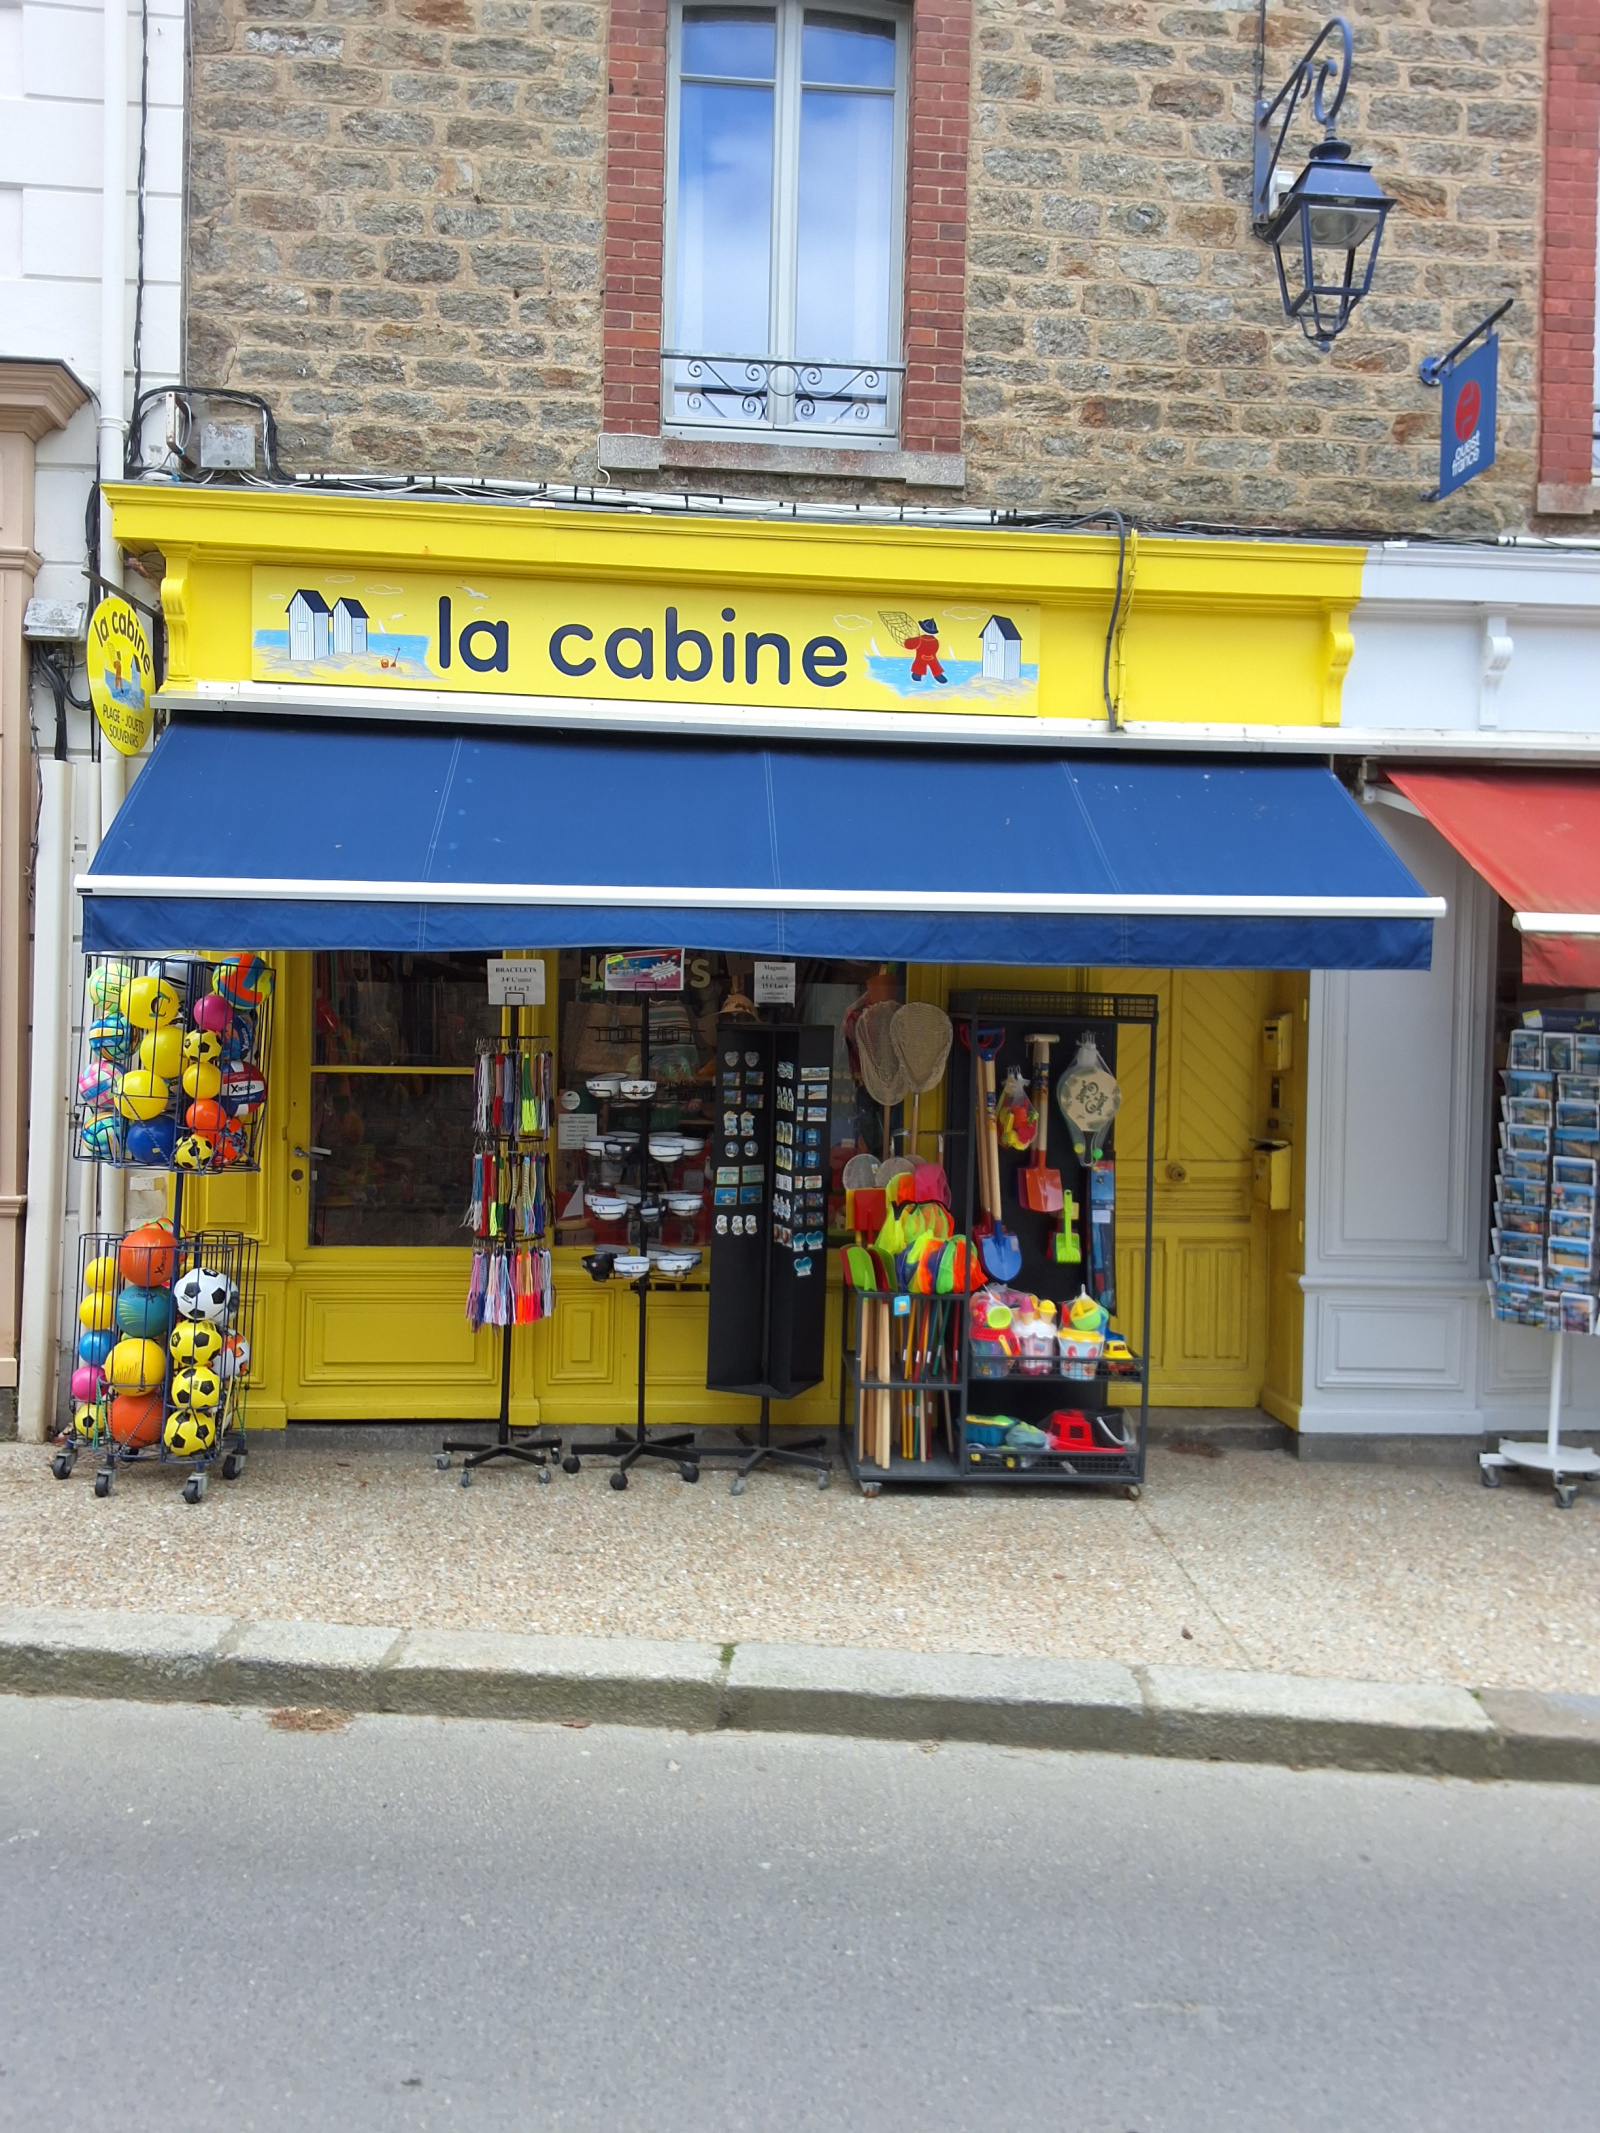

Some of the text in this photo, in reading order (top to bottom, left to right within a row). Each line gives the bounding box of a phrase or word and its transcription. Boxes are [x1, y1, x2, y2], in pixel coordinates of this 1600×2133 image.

[1455, 430, 1480, 461] ouest
[1452, 447, 1480, 477] france
[94, 609, 151, 676] la cabine
[438, 595, 848, 688] la cabine
[102, 703, 120, 724] PLAGE
[125, 714, 145, 735] JOUETS
[109, 723, 140, 749] SOUVENIRS
[763, 964, 787, 972] Magnets
